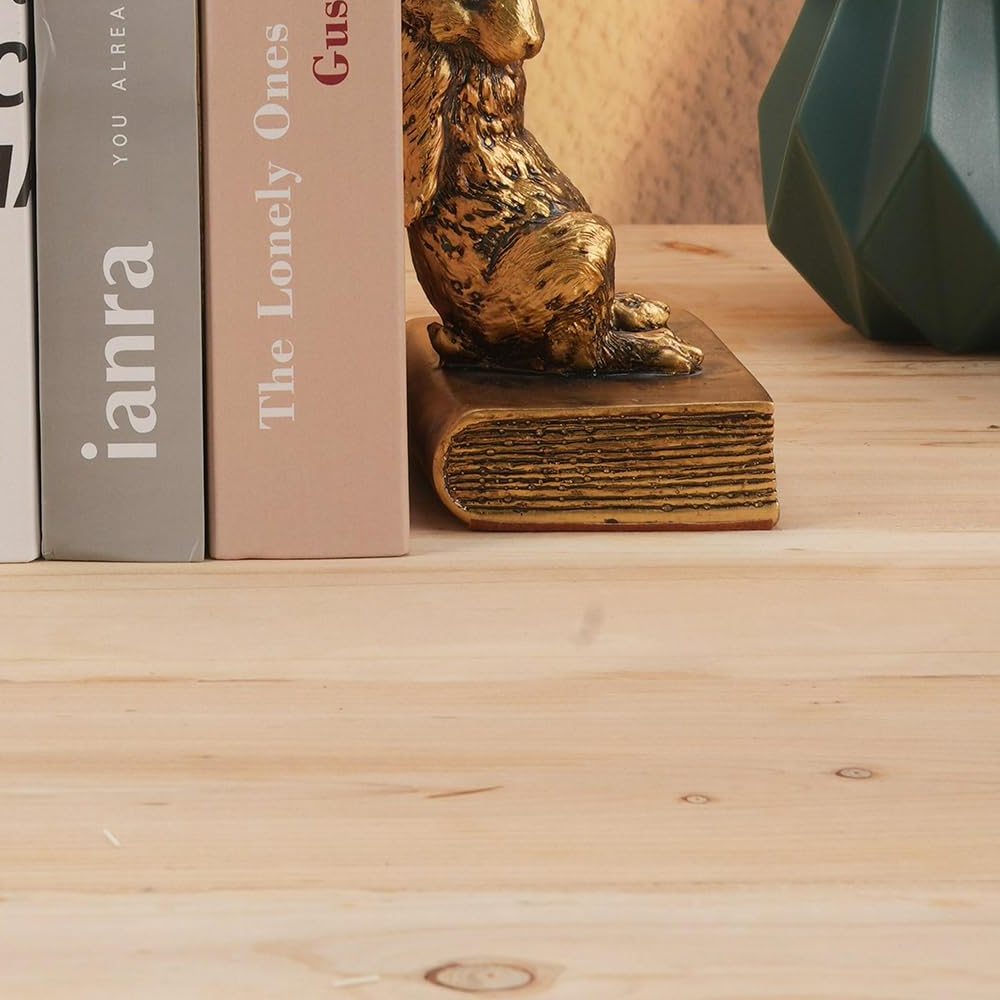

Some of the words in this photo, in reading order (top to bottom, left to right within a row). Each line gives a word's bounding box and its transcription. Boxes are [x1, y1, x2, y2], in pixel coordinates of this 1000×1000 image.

[253, 23, 291, 140] Ones
[312, 0, 350, 86] Gus
[112, 115, 129, 166] YOU
[254, 160, 303, 320] Lonely
[80, 240, 157, 460] ianra
[257, 338, 296, 430] The
